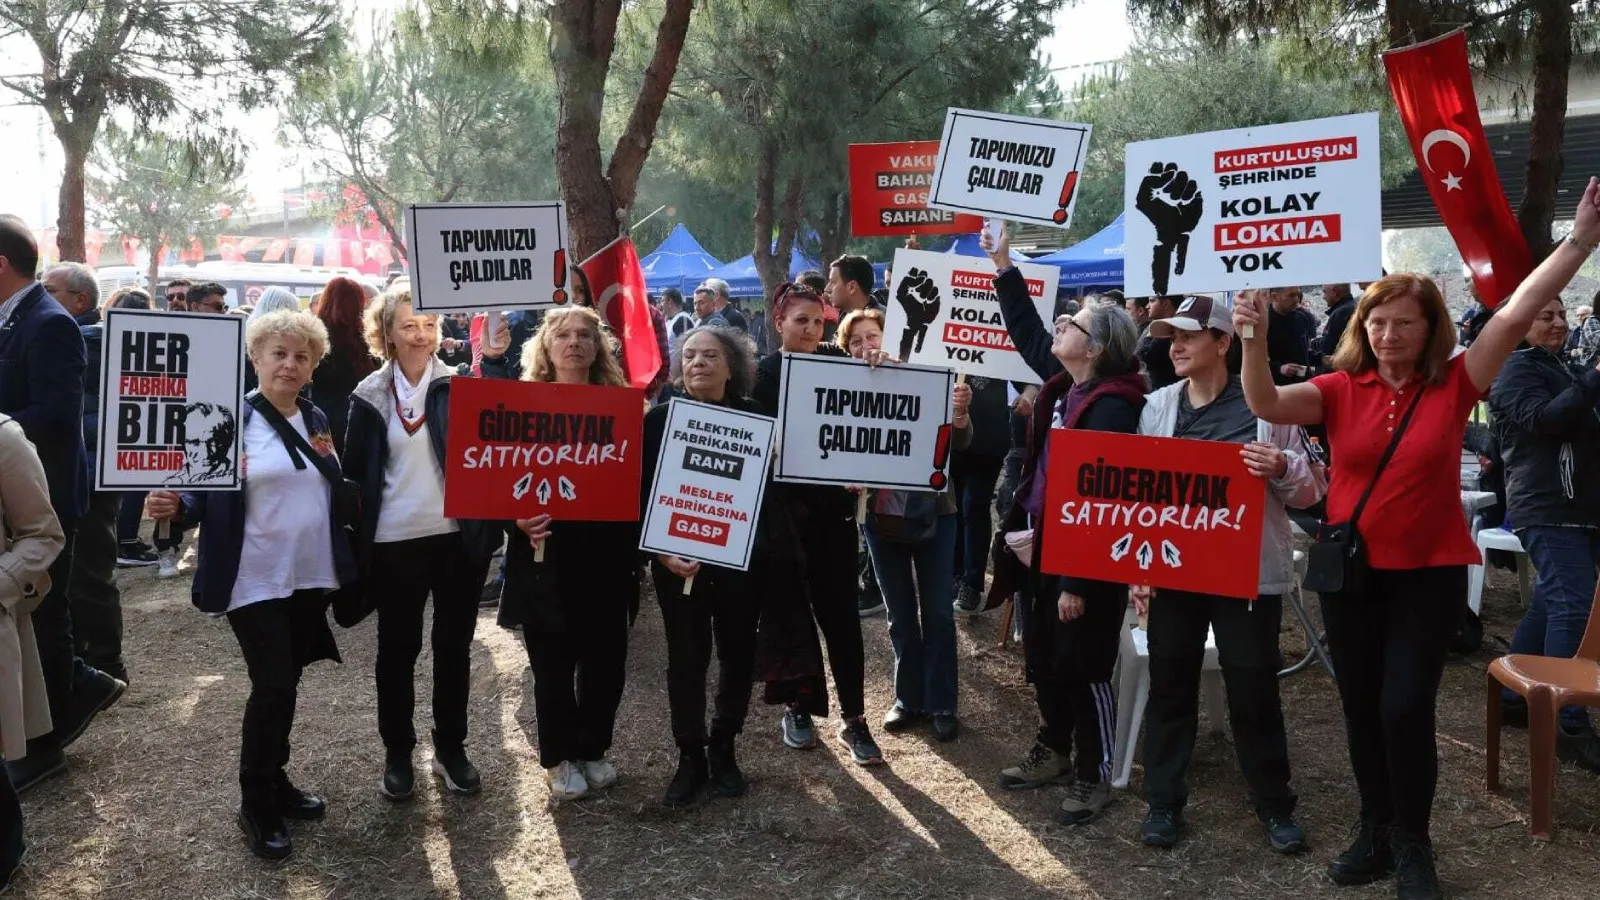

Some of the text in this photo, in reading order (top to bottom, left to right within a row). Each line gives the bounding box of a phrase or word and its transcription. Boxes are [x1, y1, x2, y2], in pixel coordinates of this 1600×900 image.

[969, 137, 1056, 168] TAPUMUZU
[1218, 142, 1353, 169] KURTULUŞUN
[967, 166, 1043, 196] ÇALDILAR
[1218, 166, 1317, 190] ŞEHRİNDE
[894, 192, 928, 205] GAS
[1220, 191, 1321, 218] KOLAY
[882, 210, 953, 226] ŞAHANE
[440, 228, 536, 253] TAPUMUZU
[1220, 219, 1328, 246] LOKMA
[450, 258, 532, 290] ÇALDILAR
[1220, 251, 1284, 273] YOK
[950, 306, 1002, 326] KOLA
[947, 326, 1016, 348] LOKMA
[121, 330, 190, 373] HER
[945, 346, 986, 364] YOK
[119, 373, 187, 396] FABRİKA
[814, 387, 921, 422] TAPUMUZU
[117, 397, 187, 444] BİR
[478, 403, 616, 444] GİDERAYAK
[687, 419, 755, 442] ELEKTRİK
[462, 439, 628, 469] SATIYORLAR!
[672, 430, 762, 458] FABRİKASINA
[818, 424, 912, 460] ÇALDILAR
[117, 446, 184, 471] KALEDİR
[689, 453, 739, 473] RANT
[679, 484, 735, 504] MESLEK
[1077, 457, 1231, 508] GİDERAYAK
[658, 495, 748, 522] FABRİKASINA
[1059, 501, 1246, 531] SATIYORLAR!
[676, 519, 723, 539] GASP
